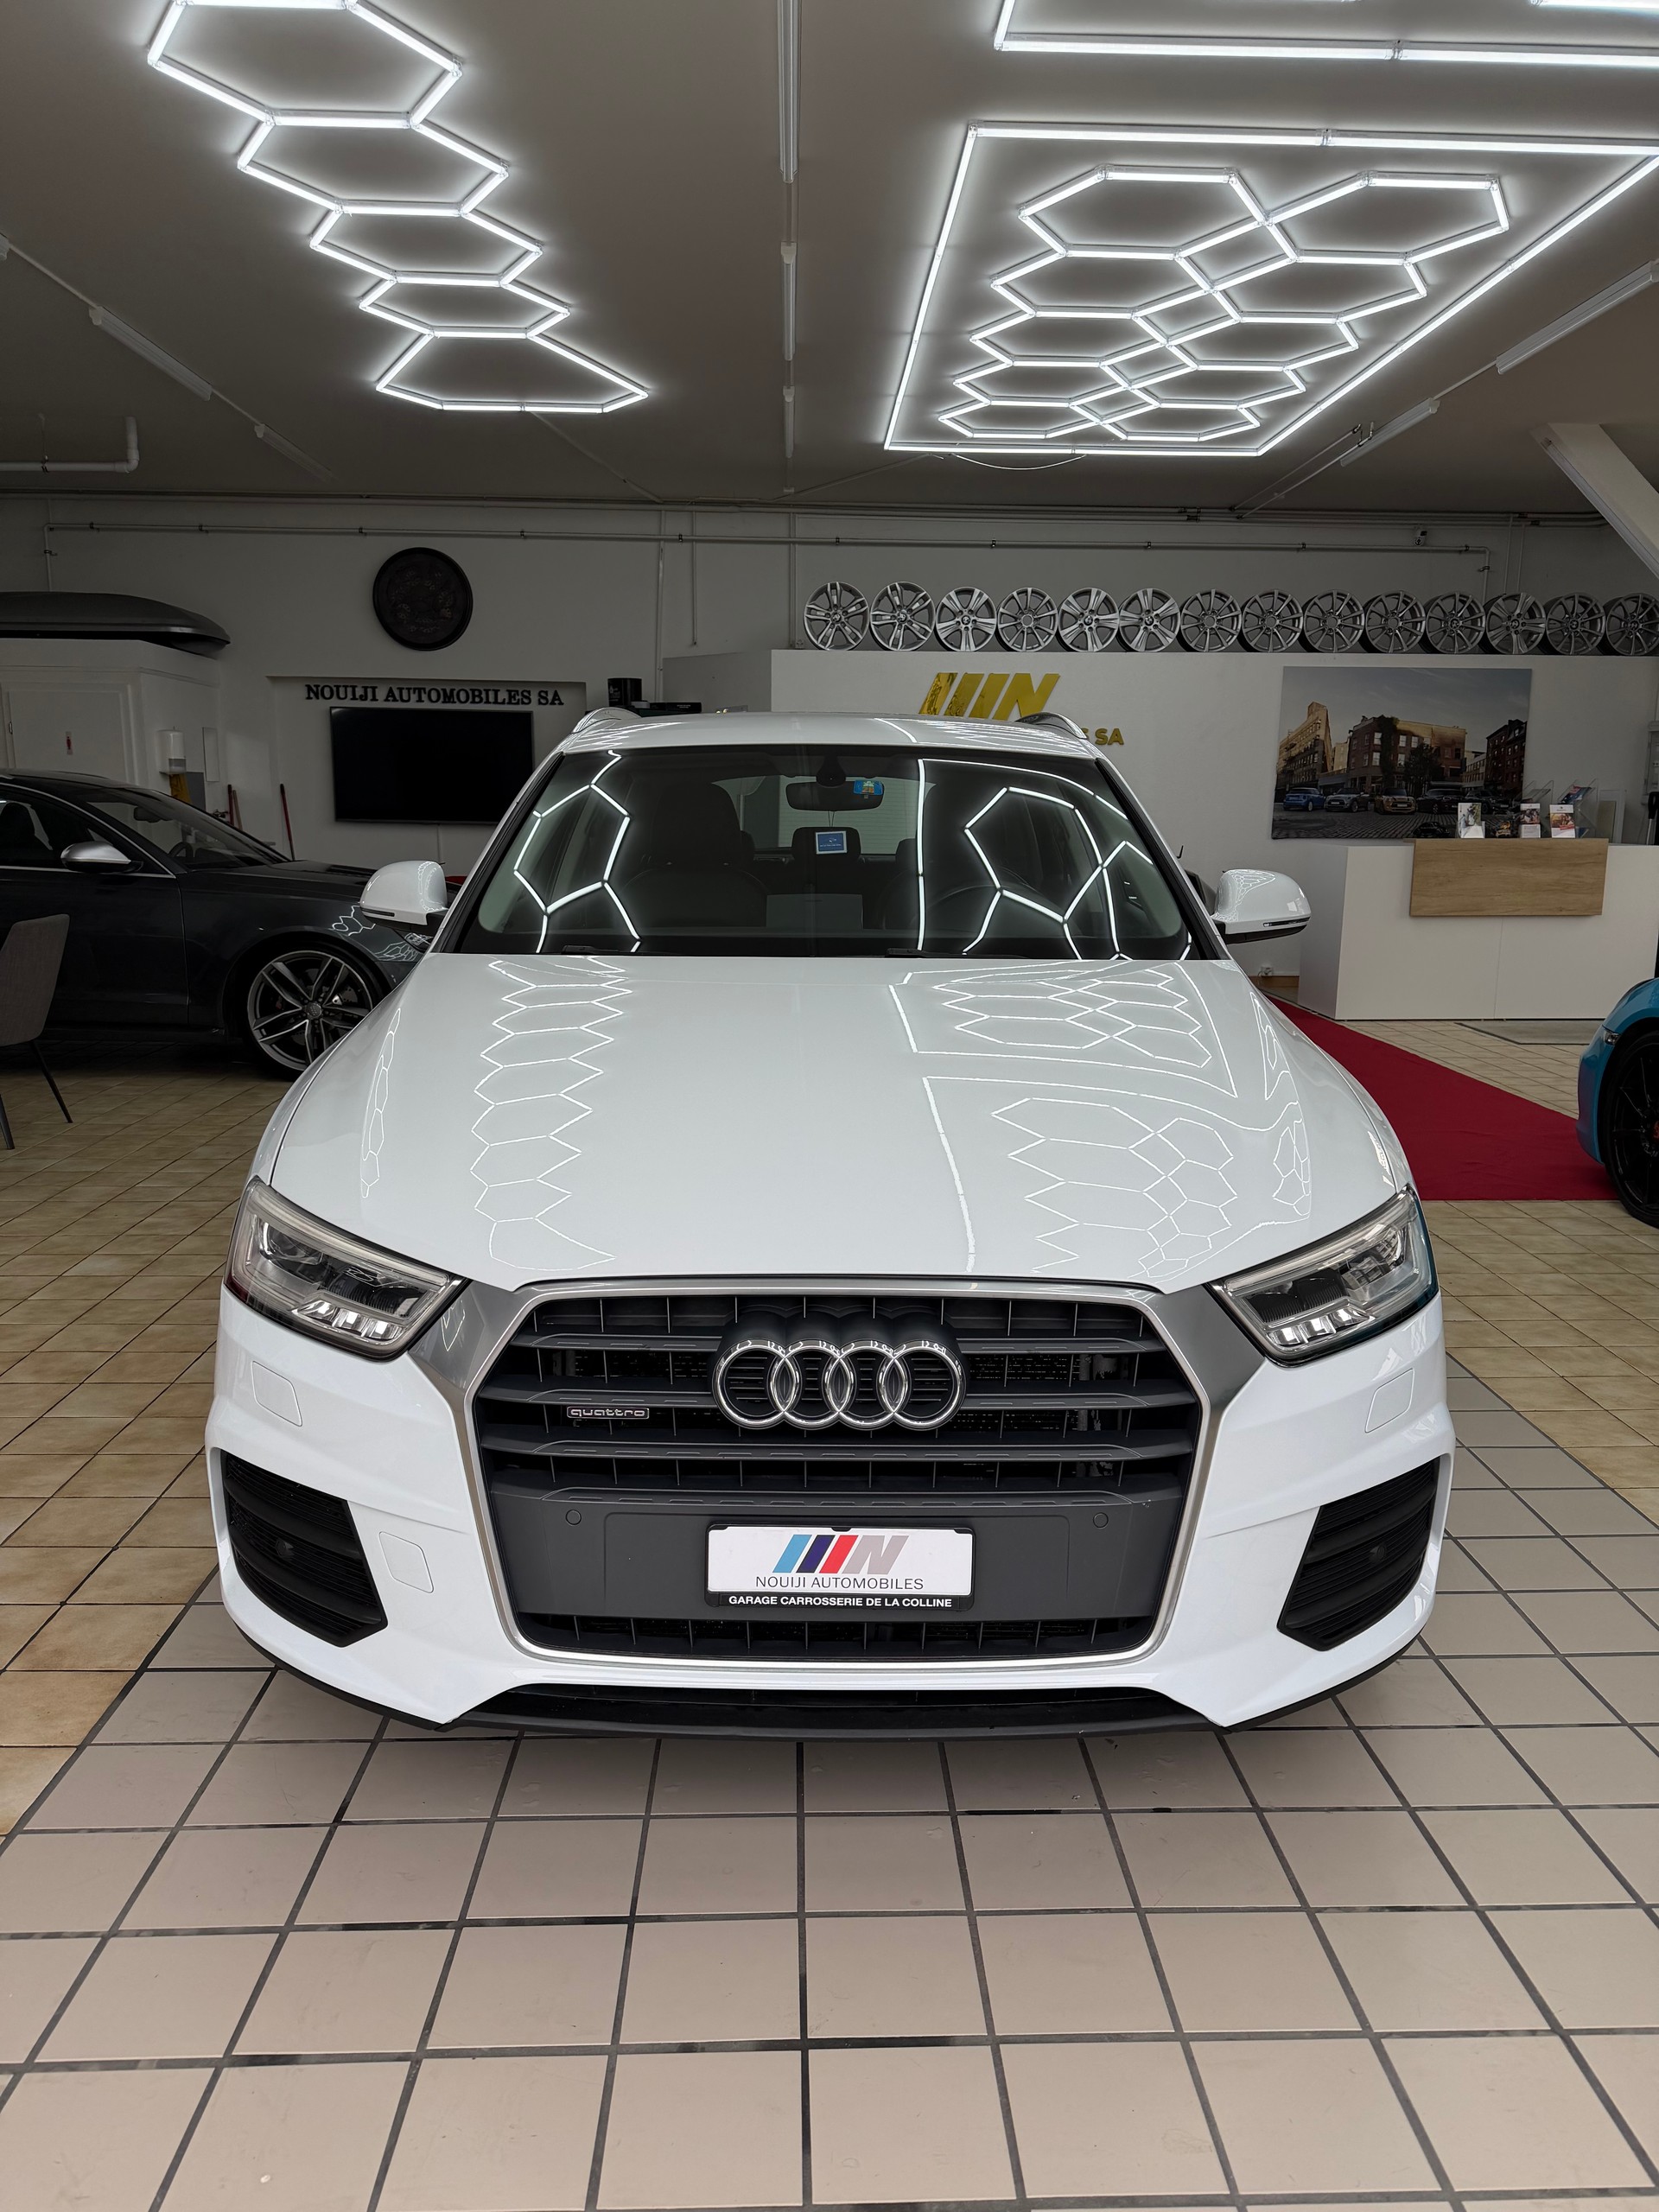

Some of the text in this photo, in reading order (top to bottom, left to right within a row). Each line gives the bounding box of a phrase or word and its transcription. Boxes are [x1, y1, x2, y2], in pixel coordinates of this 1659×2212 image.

[305, 684, 564, 706] NOUIJI AUTOMOBILES SA
[1095, 728, 1124, 746] SA
[571, 1408, 645, 1417] quattro
[755, 1576, 925, 1590] NOUIJI AUTOMOBILES
[728, 1596, 952, 1609] GARAGE CARROSSERIE DE LA COLLINE
